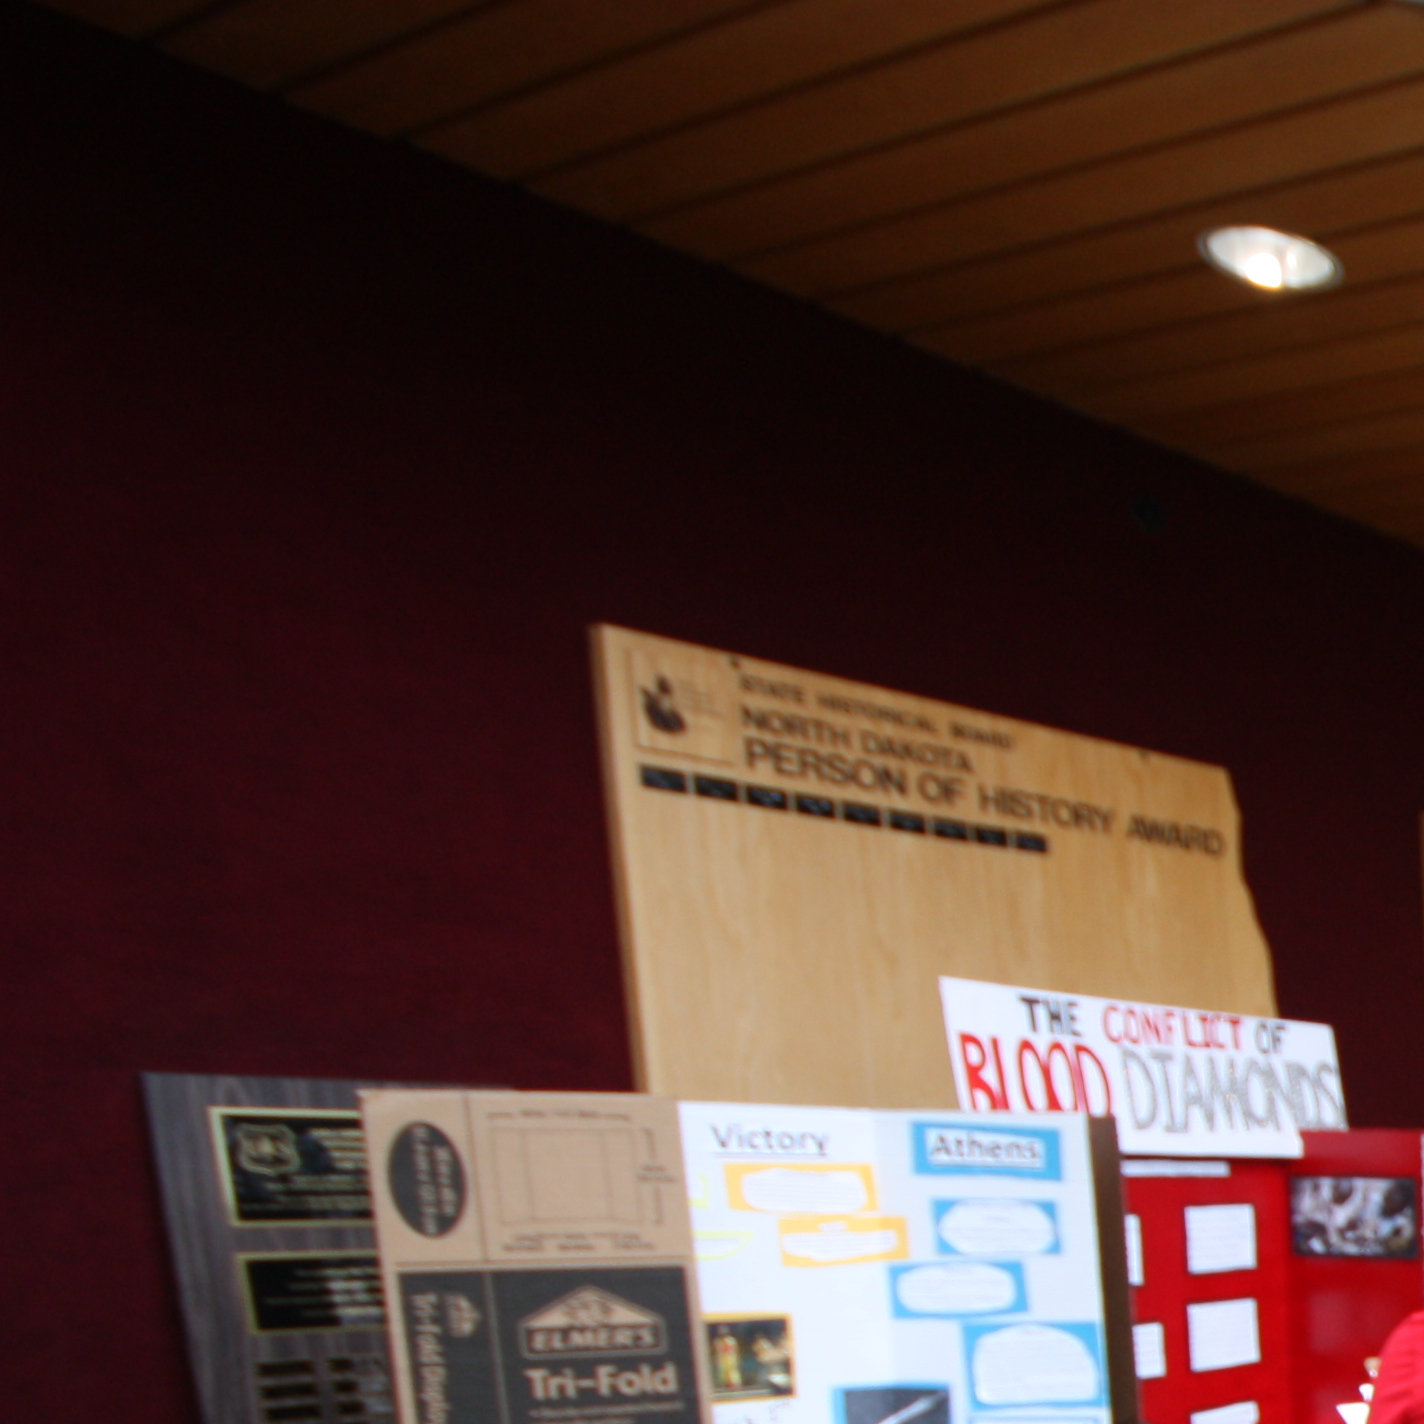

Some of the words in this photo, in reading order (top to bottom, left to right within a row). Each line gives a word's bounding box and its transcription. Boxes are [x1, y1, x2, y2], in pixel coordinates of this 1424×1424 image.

[814, 691, 938, 734] HISTORICAL
[740, 704, 851, 749] NORTH
[859, 726, 975, 775] DAKOTA
[743, 735, 908, 796] PERSON
[917, 770, 969, 807] OF
[978, 782, 1118, 836] HISTORY
[1126, 813, 1227, 860] AWARD
[1018, 995, 1082, 1037] THE
[1102, 1004, 1245, 1051] CONFLICT
[1254, 1021, 1289, 1055] OF
[957, 1032, 1114, 1115] BLOOD
[1117, 1045, 1349, 1133] DIAMONDS
[711, 1124, 828, 1157] Victory
[929, 1132, 1041, 1161] Athens
[523, 1361, 680, 1401] Tri-Fold
